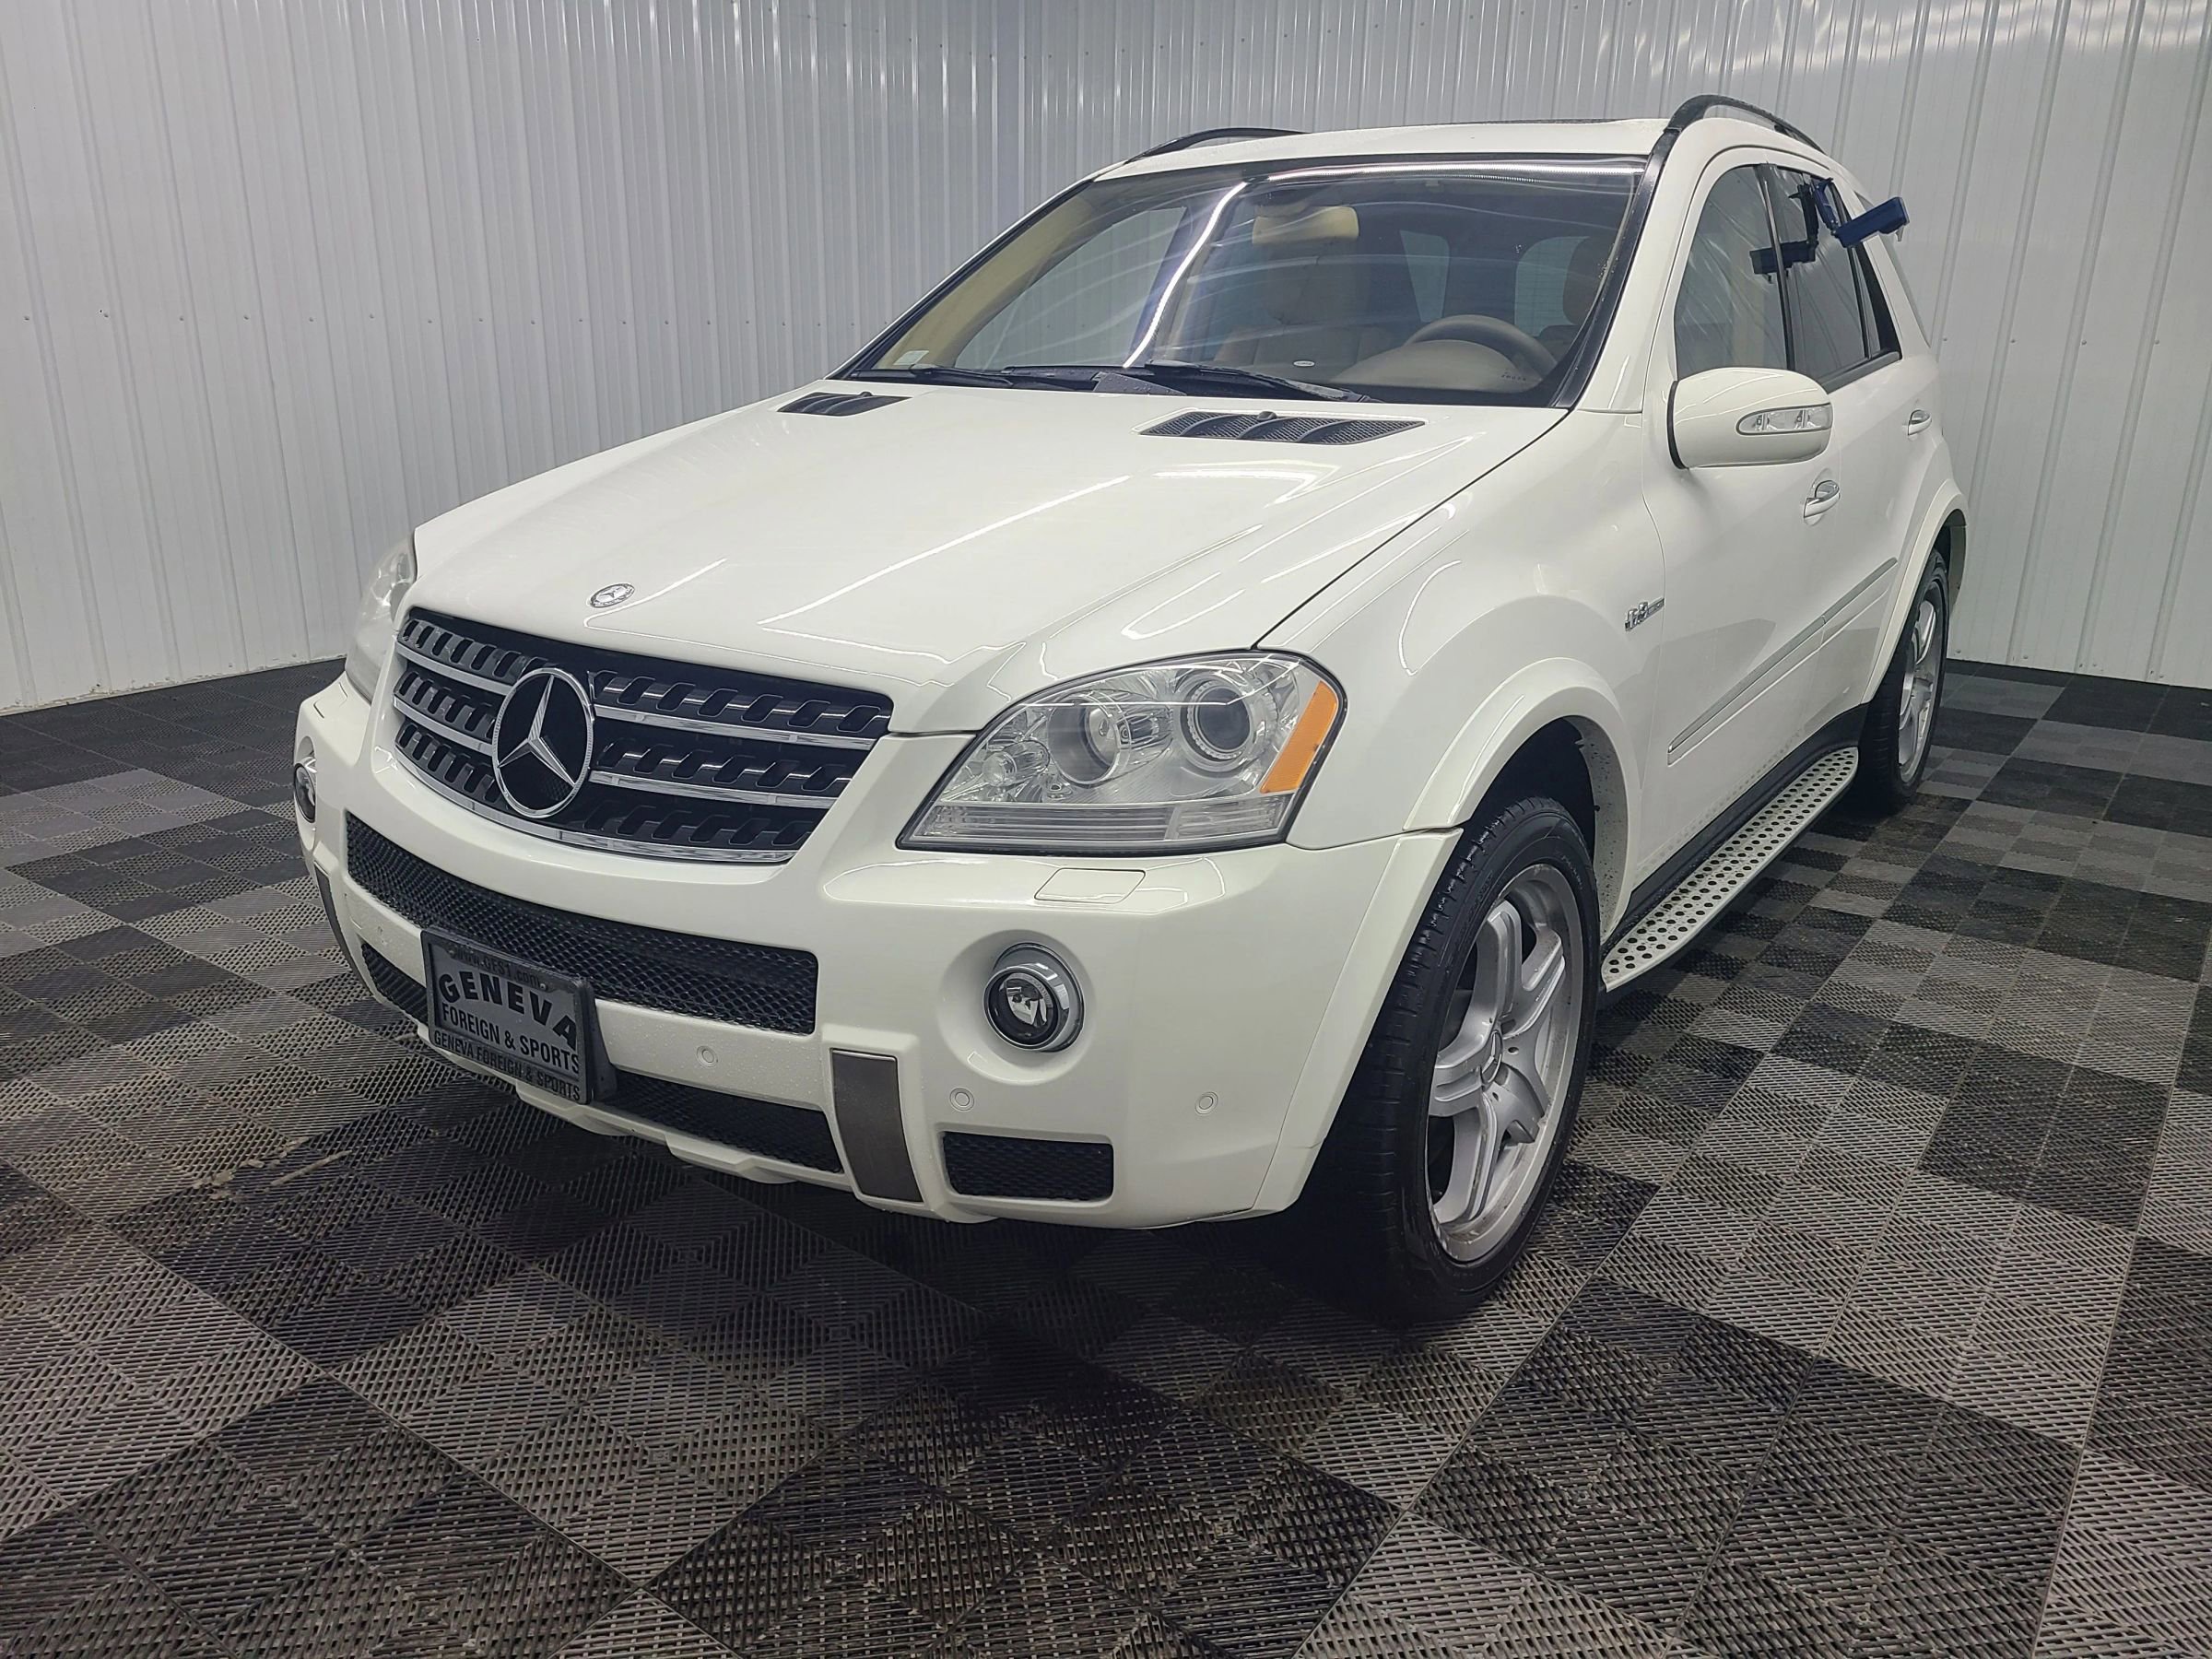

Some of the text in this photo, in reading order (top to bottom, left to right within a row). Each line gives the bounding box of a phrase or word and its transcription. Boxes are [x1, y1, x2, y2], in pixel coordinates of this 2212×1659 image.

[438, 971, 578, 1052] GENEVA
[442, 1003, 579, 1075] FOREIGN & SPORTS
[435, 1030, 474, 1059] GENEVA
[477, 1046, 522, 1078] FOREIGN
[536, 1067, 581, 1101] SPORTS
